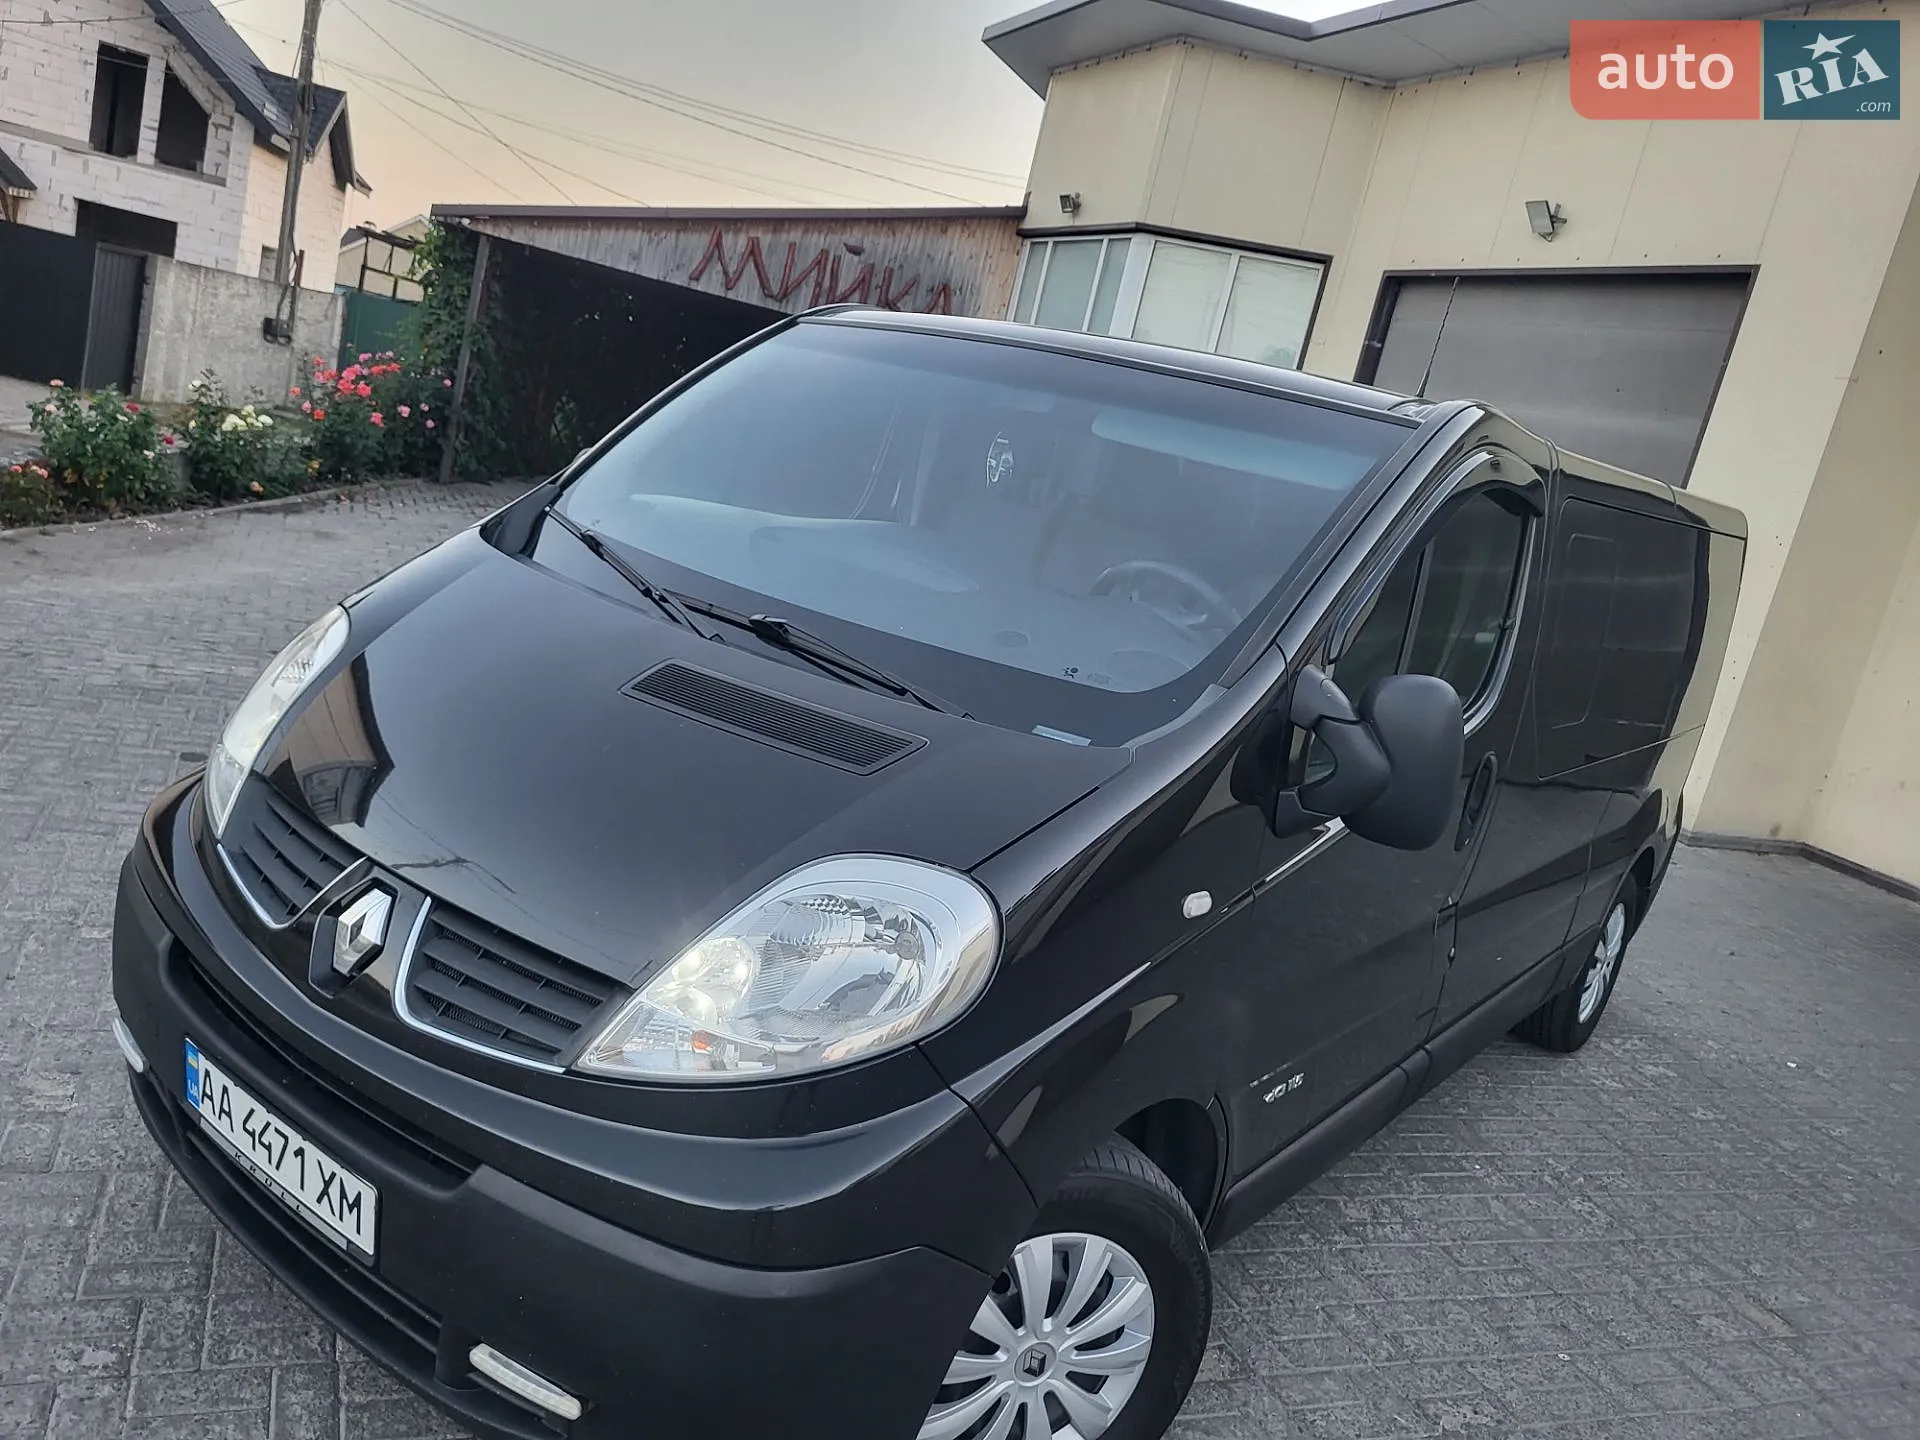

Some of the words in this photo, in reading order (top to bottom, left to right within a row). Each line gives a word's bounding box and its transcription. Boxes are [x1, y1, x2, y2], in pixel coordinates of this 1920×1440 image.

[188, 1079, 199, 1099] UA
[201, 1068, 234, 1132] AA
[242, 1108, 305, 1191] 4471
[316, 1158, 361, 1236] XM
